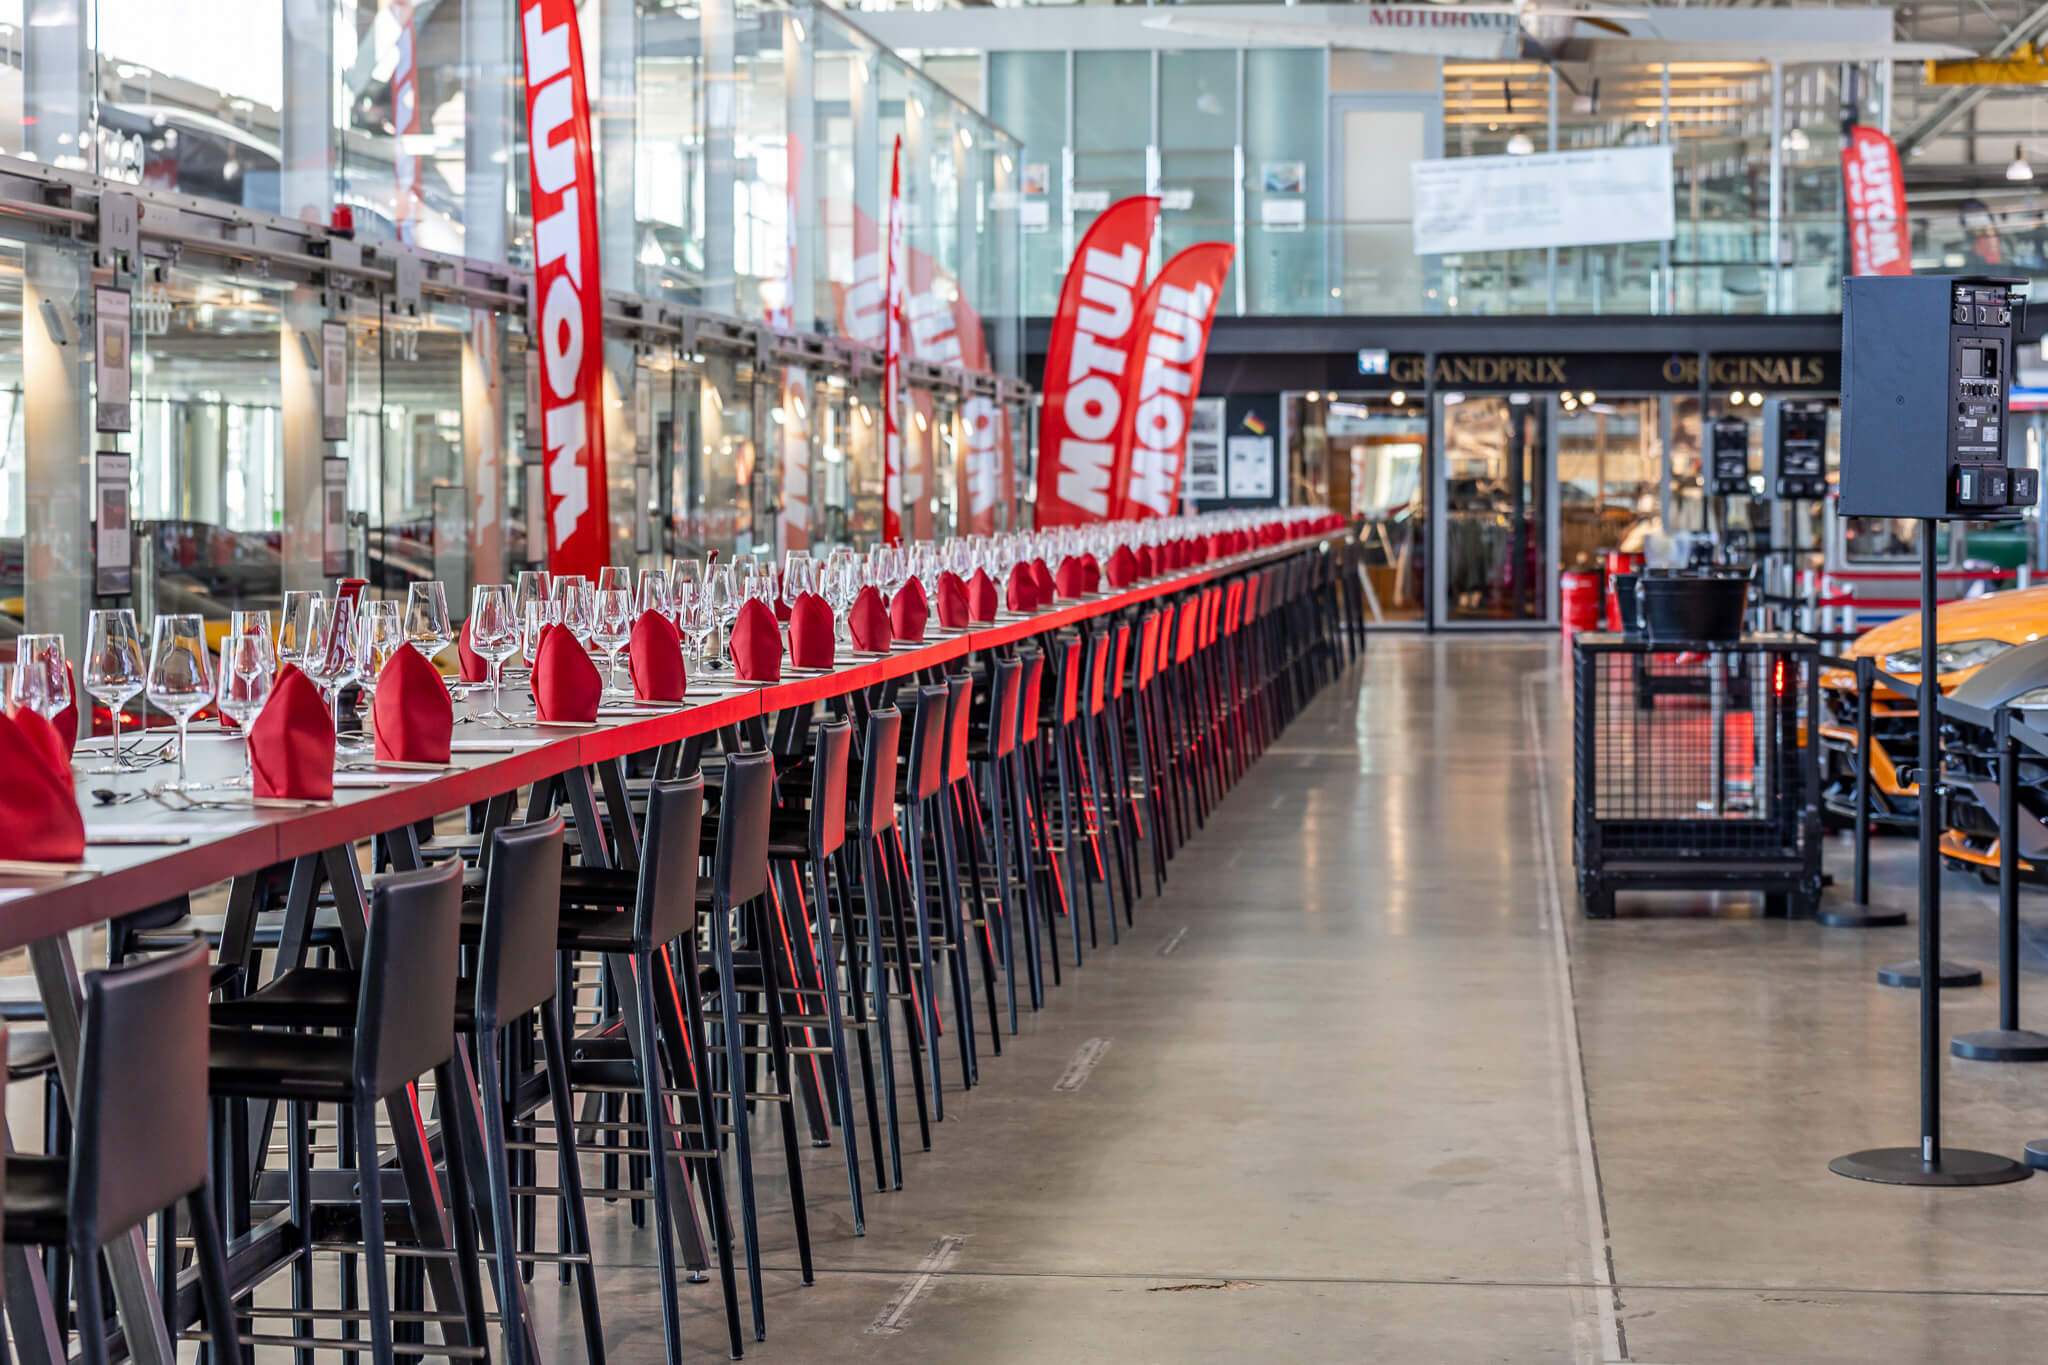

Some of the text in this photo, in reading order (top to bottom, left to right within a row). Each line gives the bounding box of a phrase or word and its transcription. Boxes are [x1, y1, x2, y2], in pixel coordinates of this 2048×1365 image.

[1057, 242, 1143, 517] MOTUL
[1129, 280, 1214, 517] MOTUL
[1663, 357, 1825, 384] ORIGINALS
